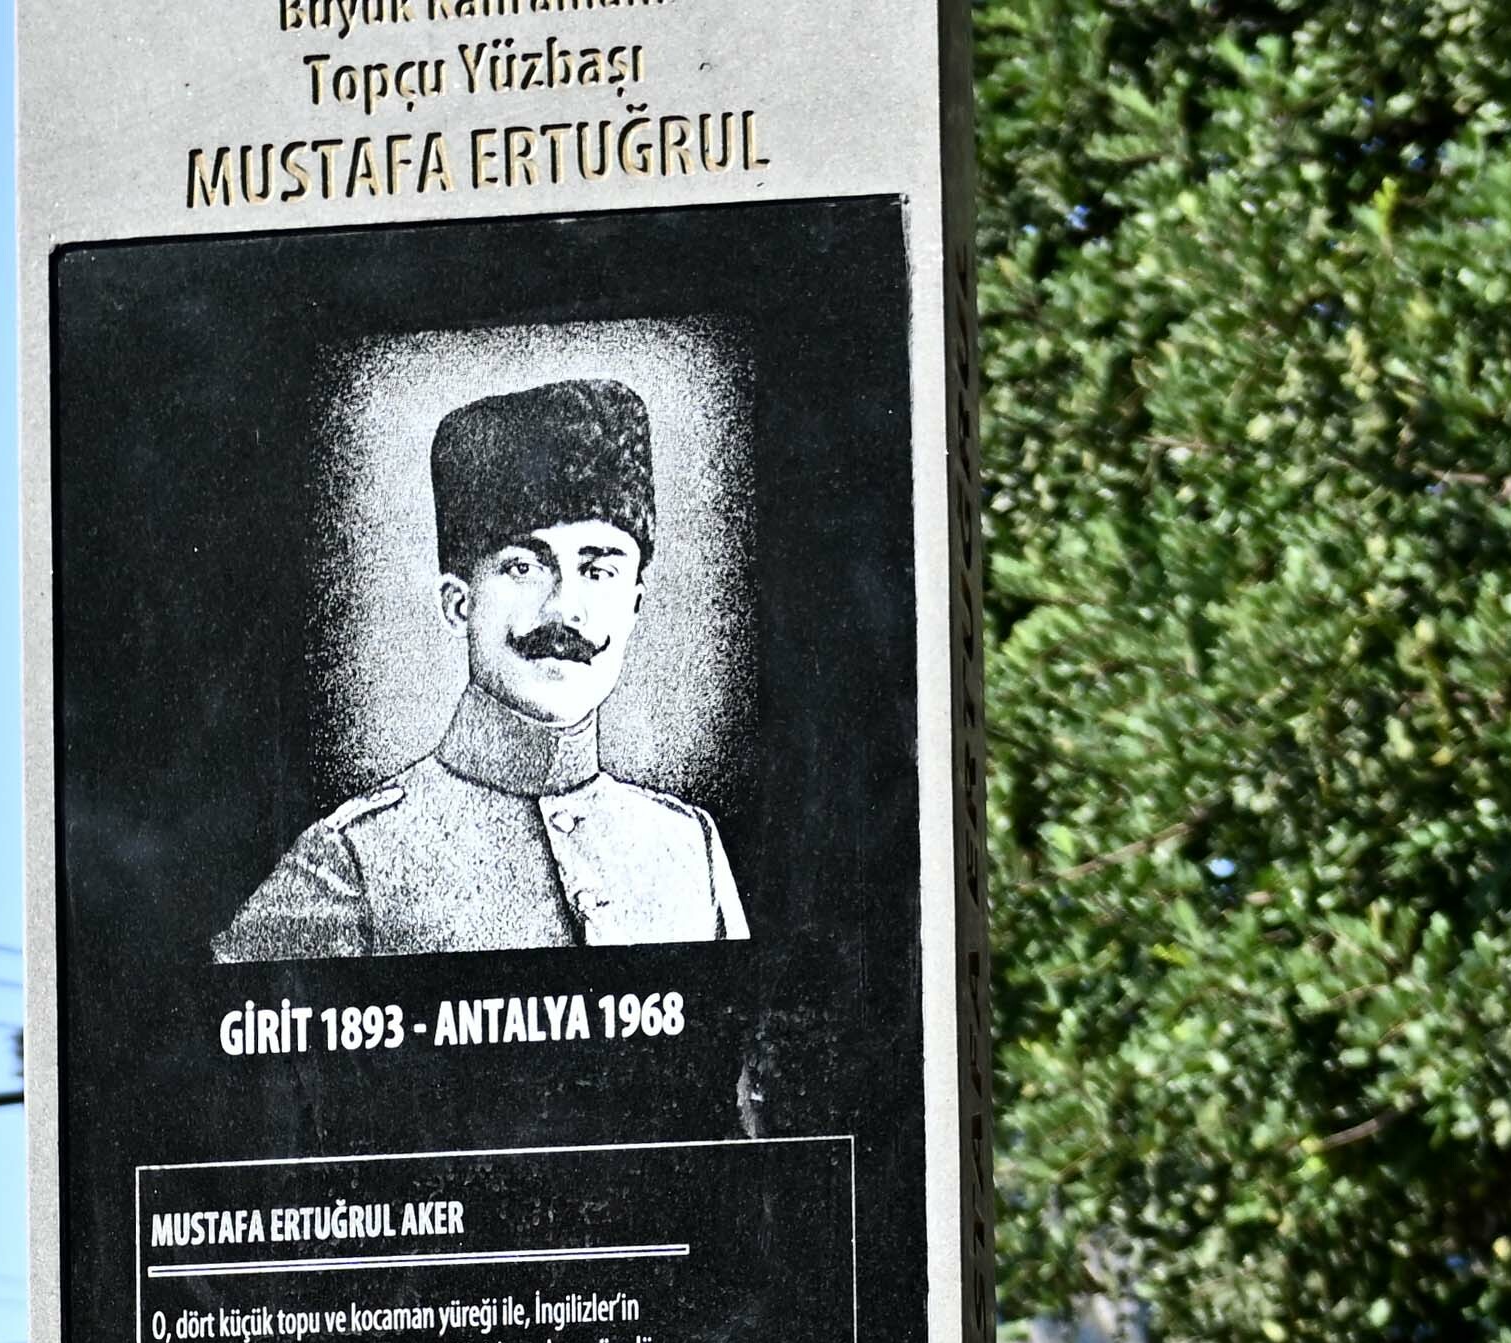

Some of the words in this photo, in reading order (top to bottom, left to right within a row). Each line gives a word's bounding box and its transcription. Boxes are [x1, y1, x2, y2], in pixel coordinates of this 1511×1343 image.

[303, 52, 446, 114] Topçu
[458, 37, 645, 96] Yüzbaşı
[185, 130, 455, 208] MUSTAFA
[471, 102, 771, 192] ERTUĞRUL
[219, 998, 312, 1055] GİRİT
[320, 1004, 404, 1050] 1893
[433, 994, 590, 1045] ANTALYA
[598, 991, 684, 1038] 1968
[151, 1209, 265, 1246] MUSTAFA
[270, 1199, 396, 1241] ERTUĞRUL
[400, 1200, 464, 1235] AKER
[350, 1301, 434, 1333] kocaman
[438, 1297, 497, 1336] yüreği
